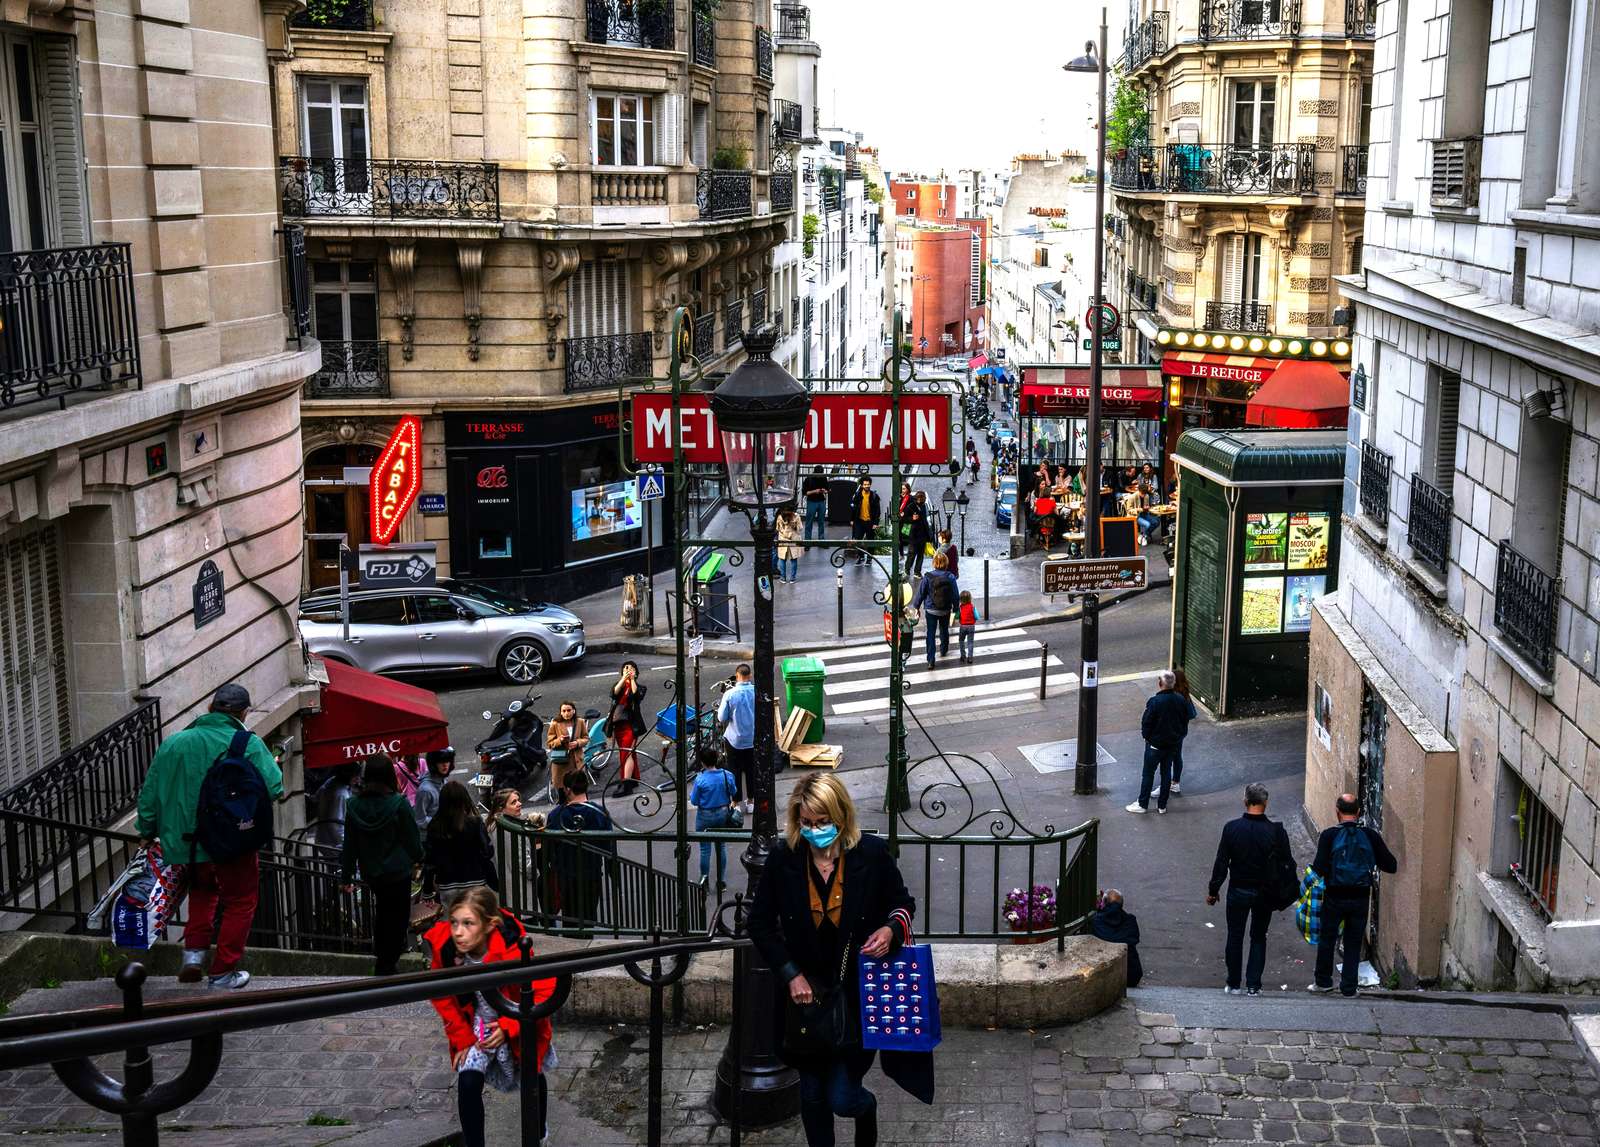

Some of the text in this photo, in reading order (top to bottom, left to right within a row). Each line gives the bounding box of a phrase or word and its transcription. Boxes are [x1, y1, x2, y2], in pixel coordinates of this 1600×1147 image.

[1191, 365, 1262, 381] LE REFUGE
[1053, 387, 1073, 396] LE
[464, 423, 524, 433] TERRASSE
[381, 442, 412, 520] TABAC
[1290, 540, 1316, 548] MOSCOU
[369, 563, 400, 576] FDJ
[1057, 565, 1119, 574] Butte Montmartre
[203, 582, 214, 593] RUE
[343, 739, 401, 759] TABAC
